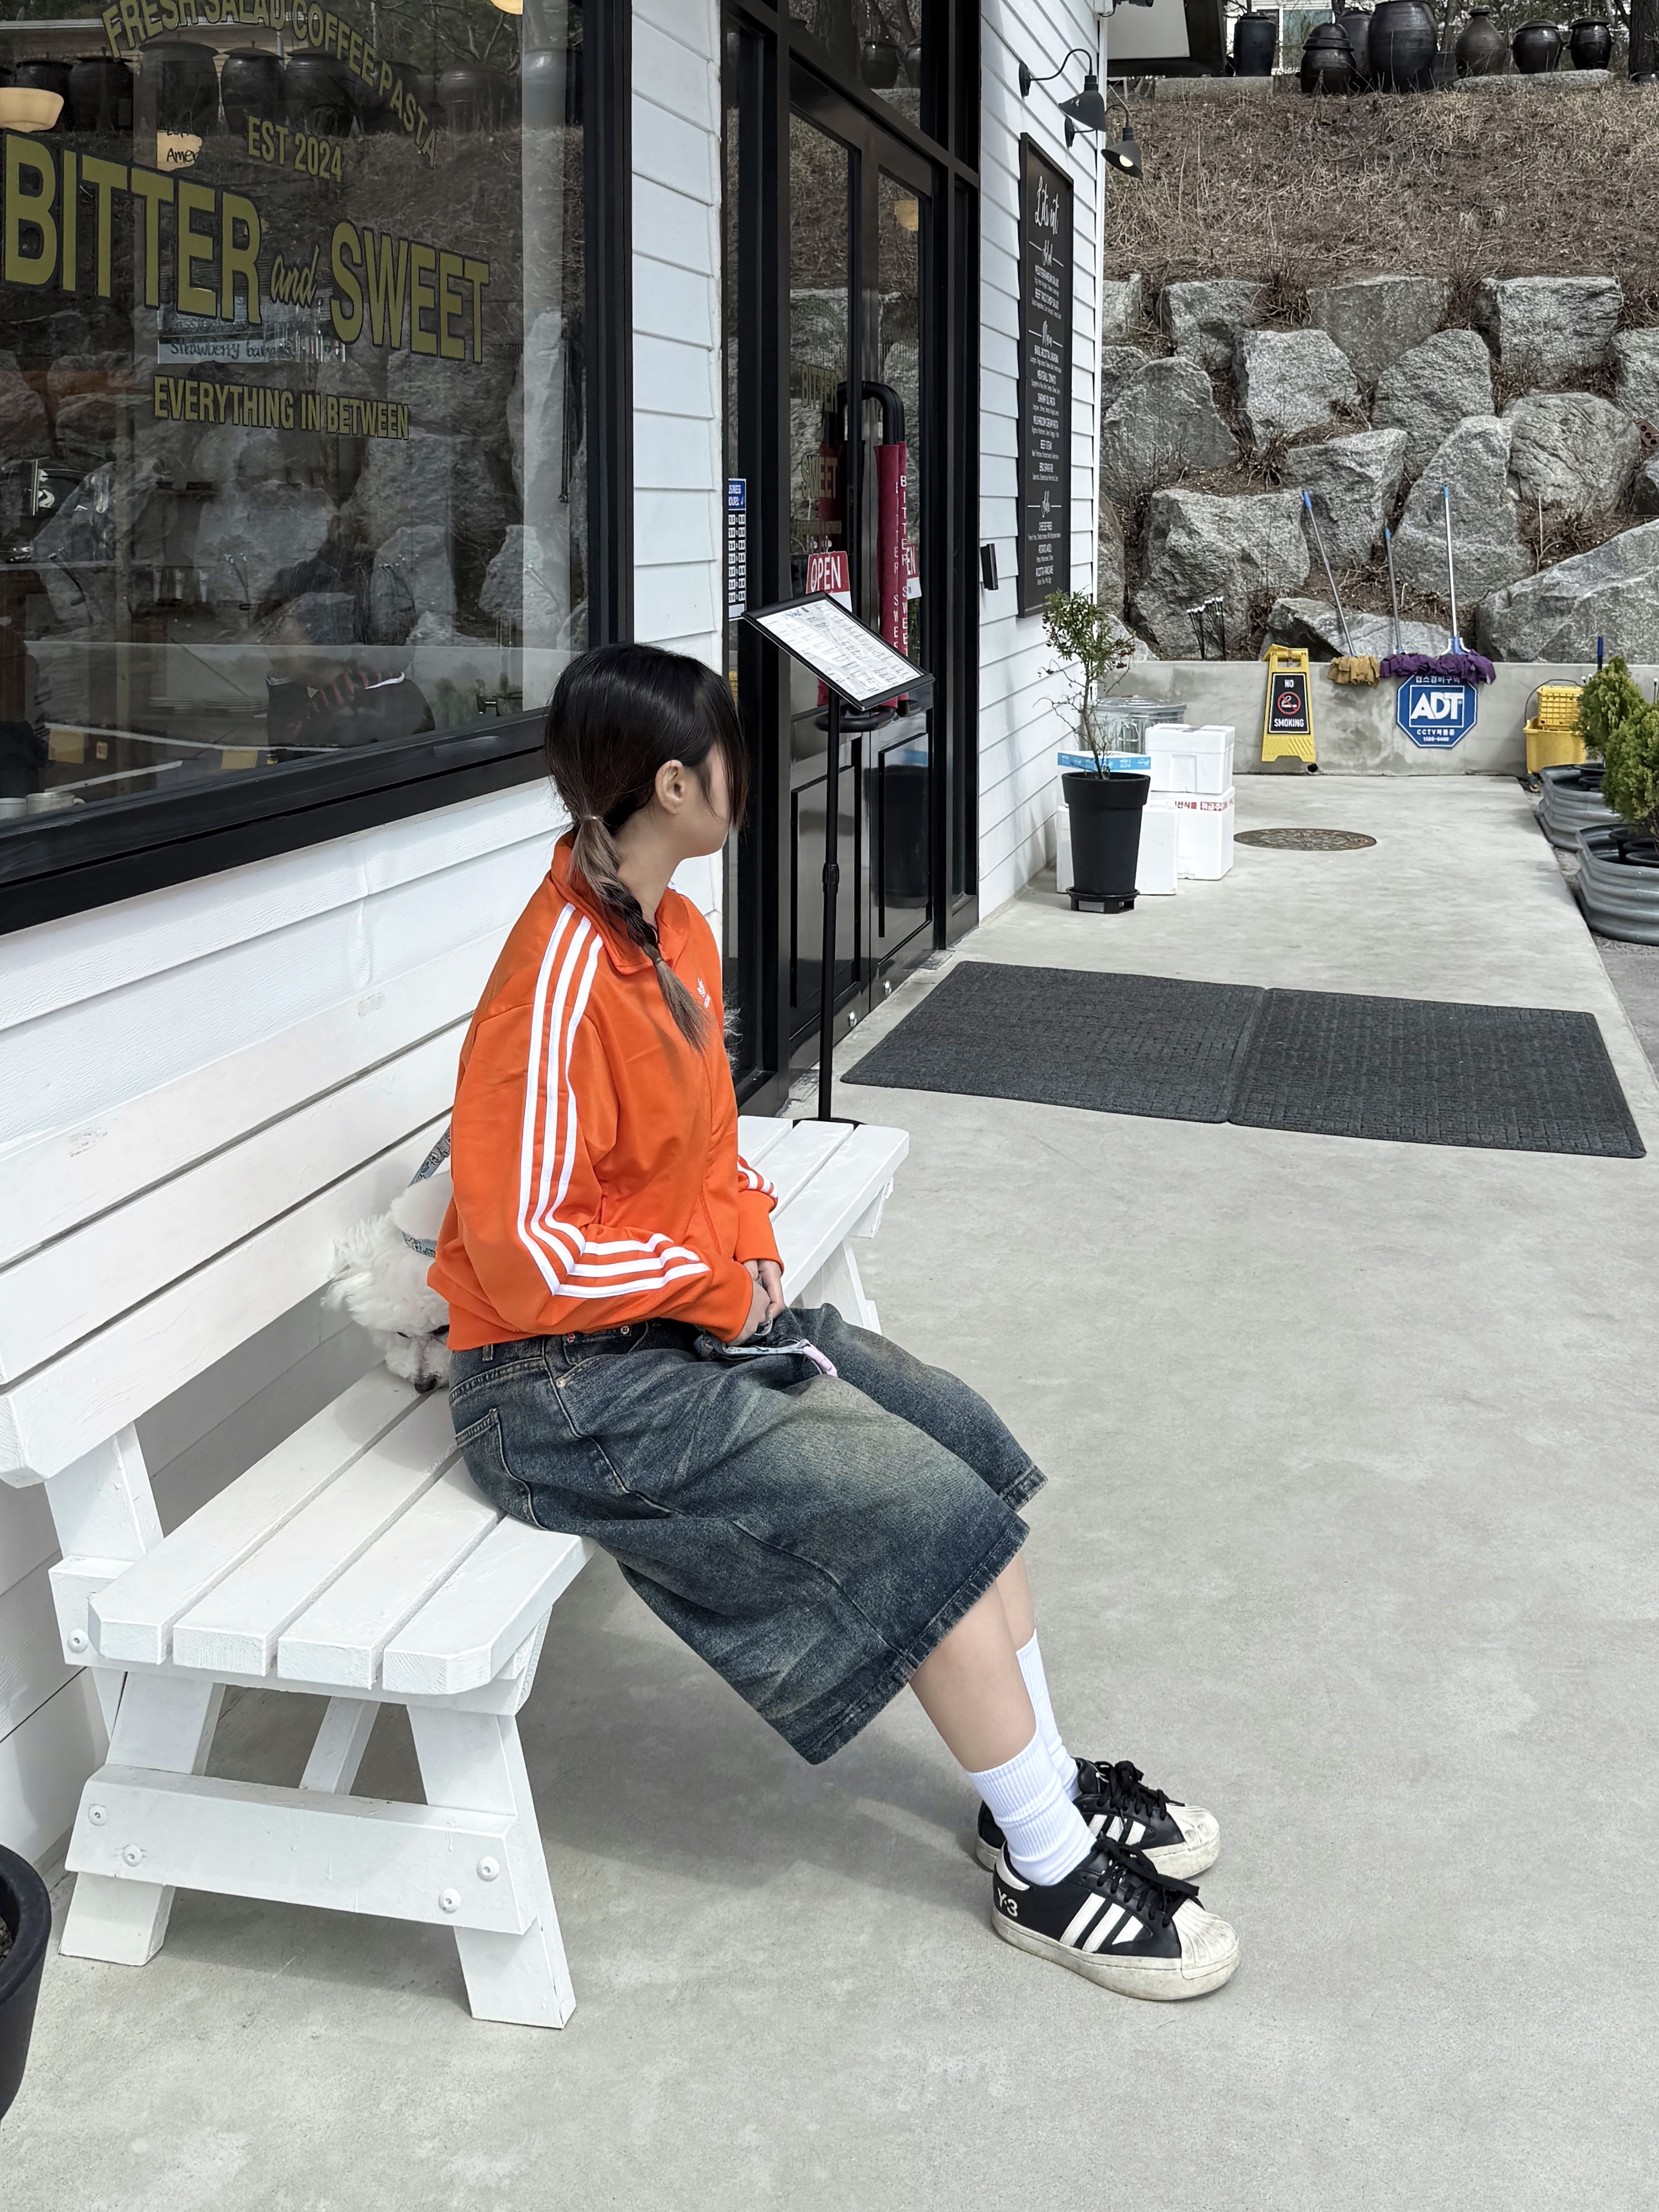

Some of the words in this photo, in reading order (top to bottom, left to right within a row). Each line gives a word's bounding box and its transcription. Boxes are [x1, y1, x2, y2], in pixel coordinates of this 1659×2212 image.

[102, 0, 198, 59] FRESH
[205, 0, 286, 30] SALAD
[292, 0, 376, 86] COFFEE
[379, 59, 436, 169] PASTA
[248, 116, 288, 166] EST
[295, 133, 342, 182] 2024
[4, 133, 262, 326] BITTER
[270, 244, 320, 308] and
[331, 220, 490, 365] SWEET
[154, 375, 294, 430] EVERYTHING
[301, 391, 322, 432] IN
[326, 394, 409, 440] BETWEEN
[802, 363, 838, 413] BITTER
[802, 453, 838, 499] SWEET
[811, 556, 841, 593] OPEN
[1285, 679, 1294, 688] NO
[1411, 692, 1464, 720] ADT
[1274, 718, 1304, 727] SMOKING
[997, 1887, 1018, 1917] Y-3
